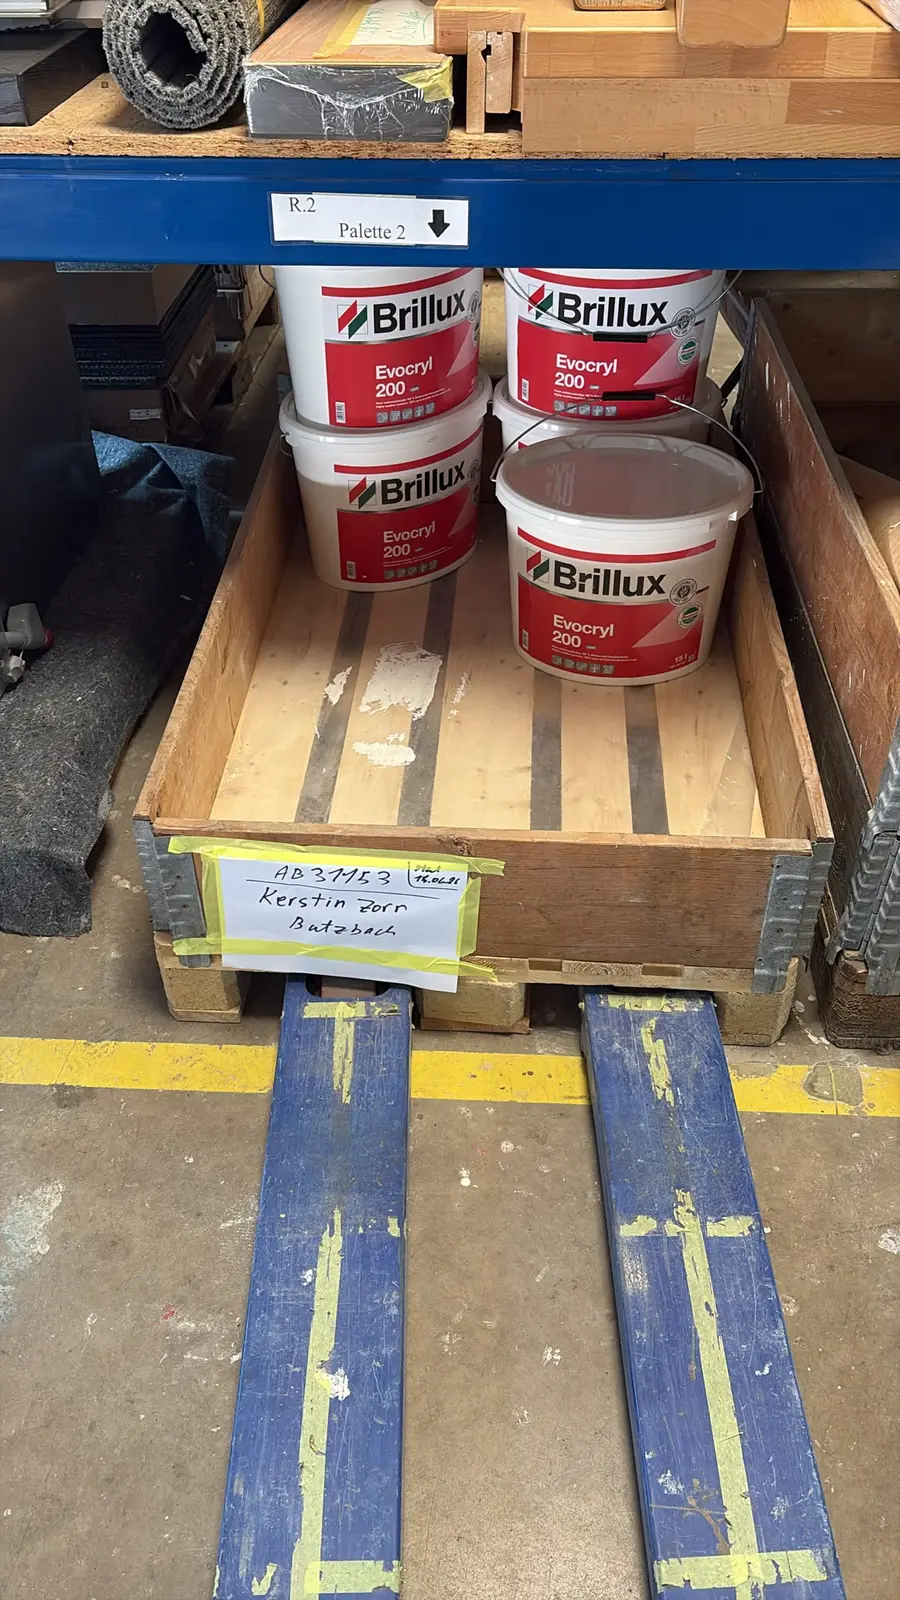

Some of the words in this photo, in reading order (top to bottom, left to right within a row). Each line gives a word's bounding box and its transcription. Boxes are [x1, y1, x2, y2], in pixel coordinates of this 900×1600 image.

[288, 197, 316, 213] R.2
[338, 222, 392, 239] Palette
[396, 225, 406, 240] 2
[373, 289, 466, 334] Brillux
[557, 292, 669, 327] Brillux
[375, 356, 433, 380] Evocryl
[555, 353, 618, 376] Evocryl
[375, 381, 406, 398] 200
[554, 372, 585, 390] 200
[380, 460, 466, 505] Brillux
[383, 520, 436, 544] Evocryl
[383, 543, 411, 559] 200
[553, 560, 667, 597] Brillux
[553, 613, 615, 639] Evocryl
[552, 630, 582, 648] 200
[258, 886, 346, 910] Kerstin
[357, 898, 408, 914] Zorn
